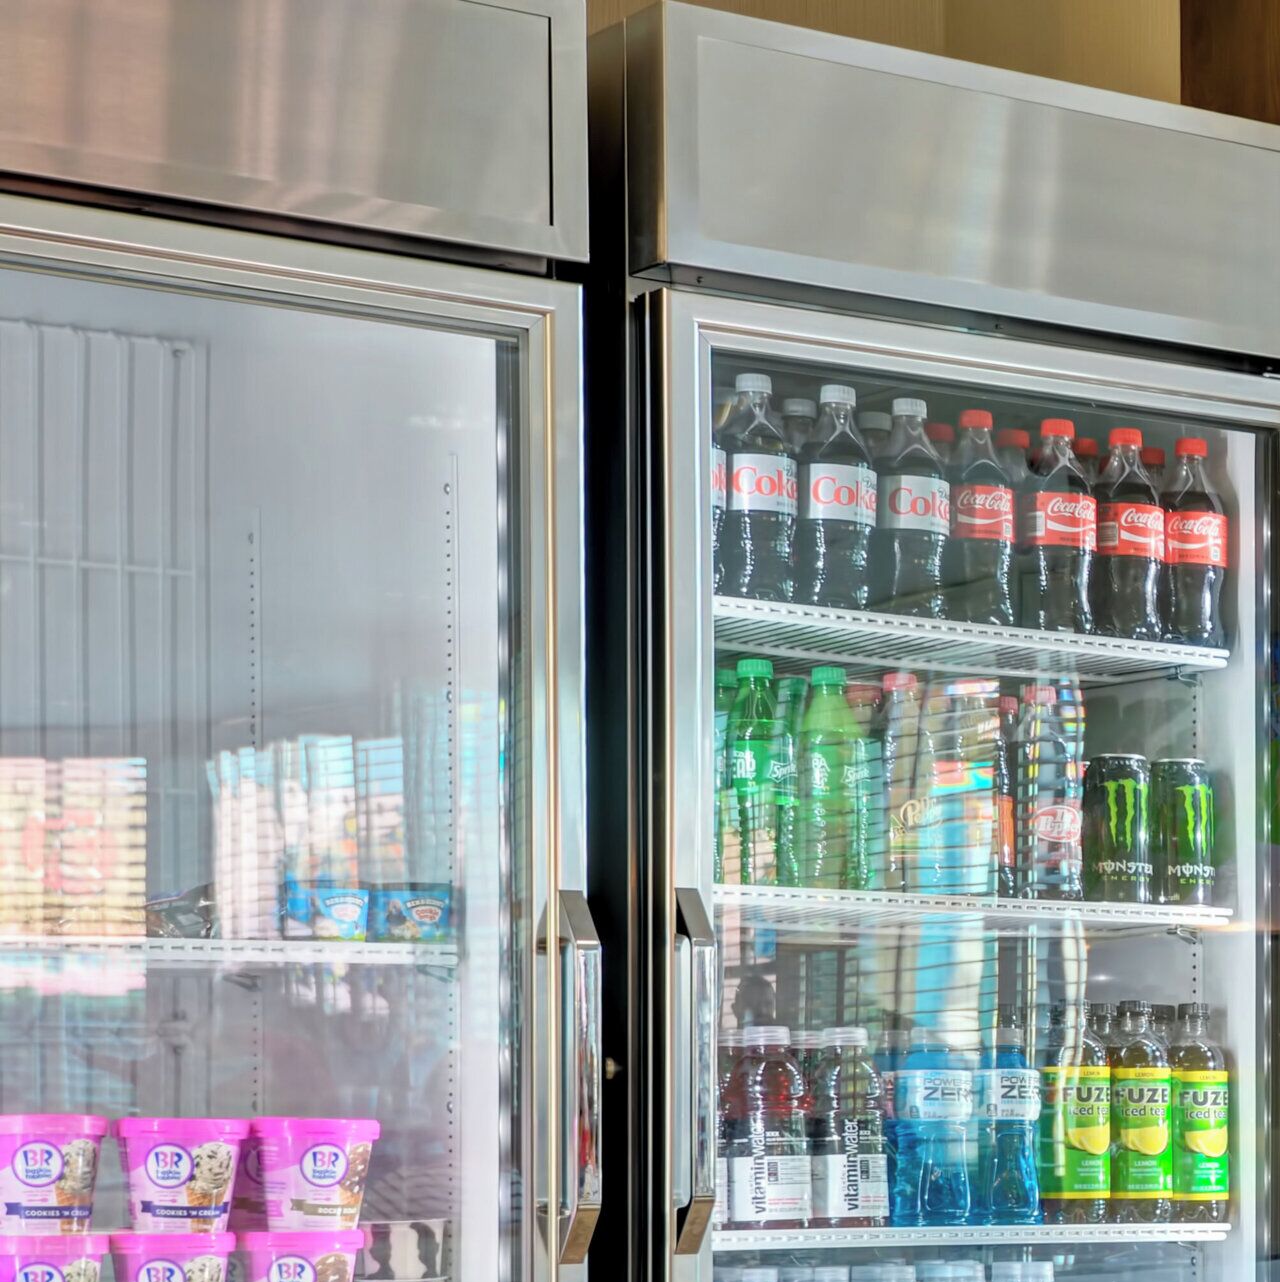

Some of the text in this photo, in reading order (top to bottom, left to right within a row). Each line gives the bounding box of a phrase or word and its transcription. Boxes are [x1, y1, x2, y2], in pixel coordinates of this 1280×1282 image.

[732, 466, 798, 500] Coke
[812, 476, 877, 511] Coke
[1115, 1087, 1169, 1104] FUZE
[1122, 1105, 1147, 1117] iced
[1185, 1109, 1211, 1120] iced
[156, 1207, 188, 1217] COOKIES
